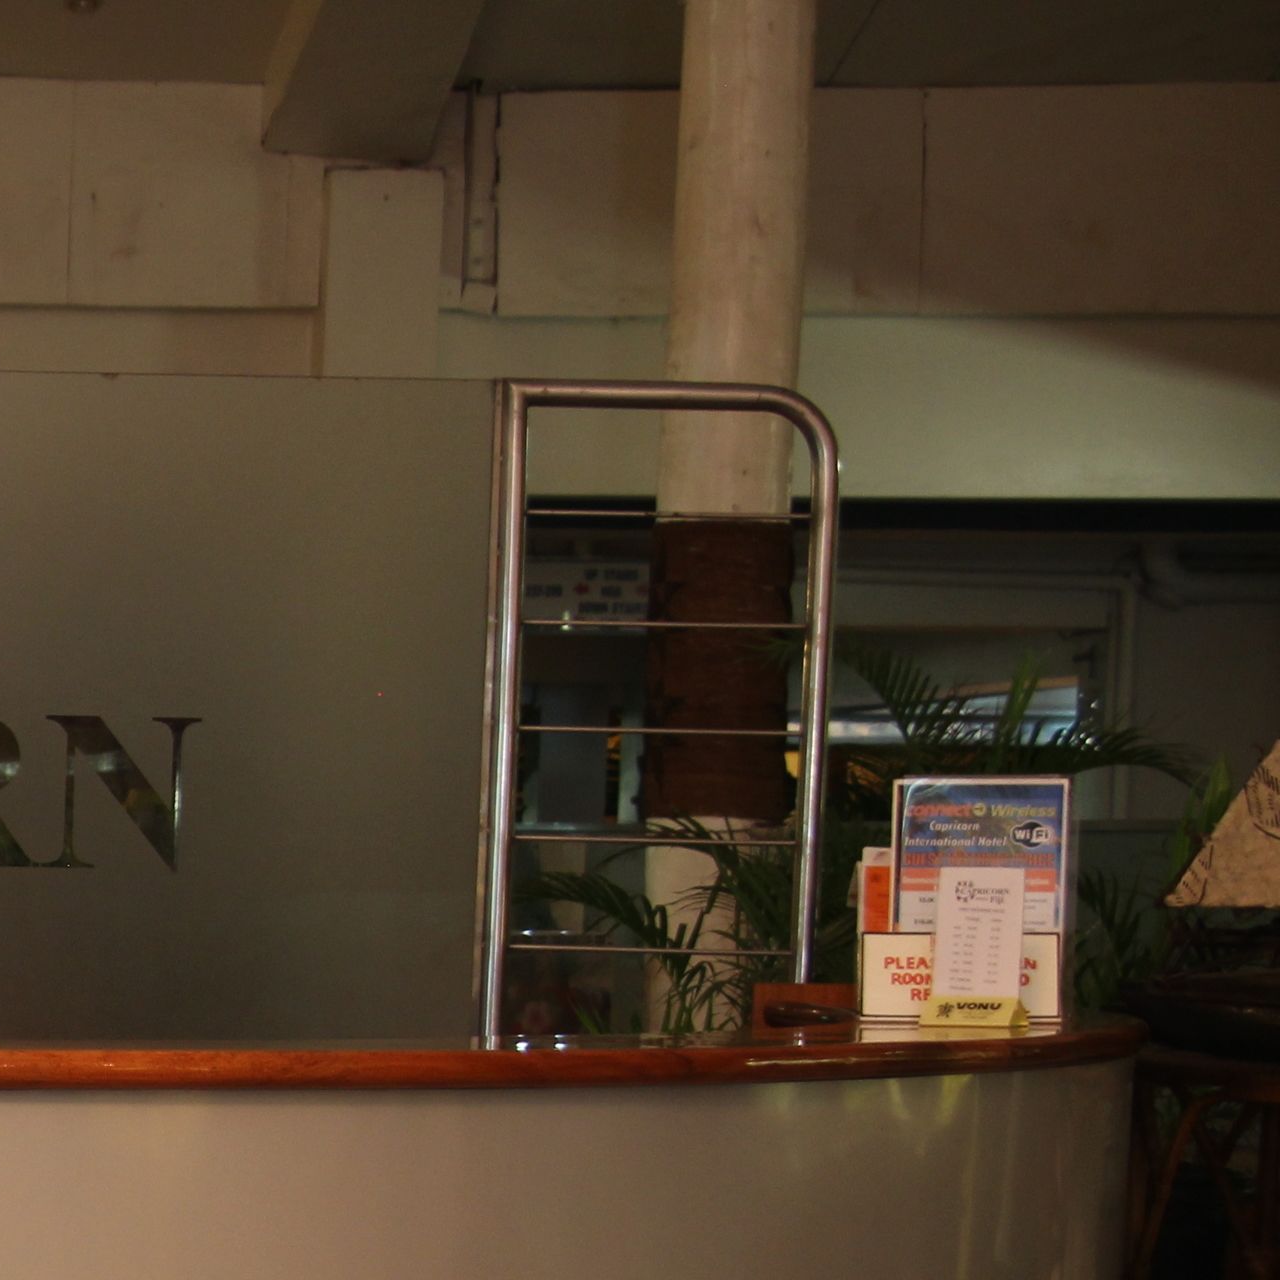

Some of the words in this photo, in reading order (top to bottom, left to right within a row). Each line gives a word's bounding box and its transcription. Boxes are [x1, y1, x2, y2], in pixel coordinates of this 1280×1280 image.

[991, 804, 1057, 816] Wireless
[929, 820, 981, 832] Capricorn
[904, 836, 976, 847] International
[977, 836, 1007, 847] Hotel
[956, 1002, 1002, 1011] VONU
